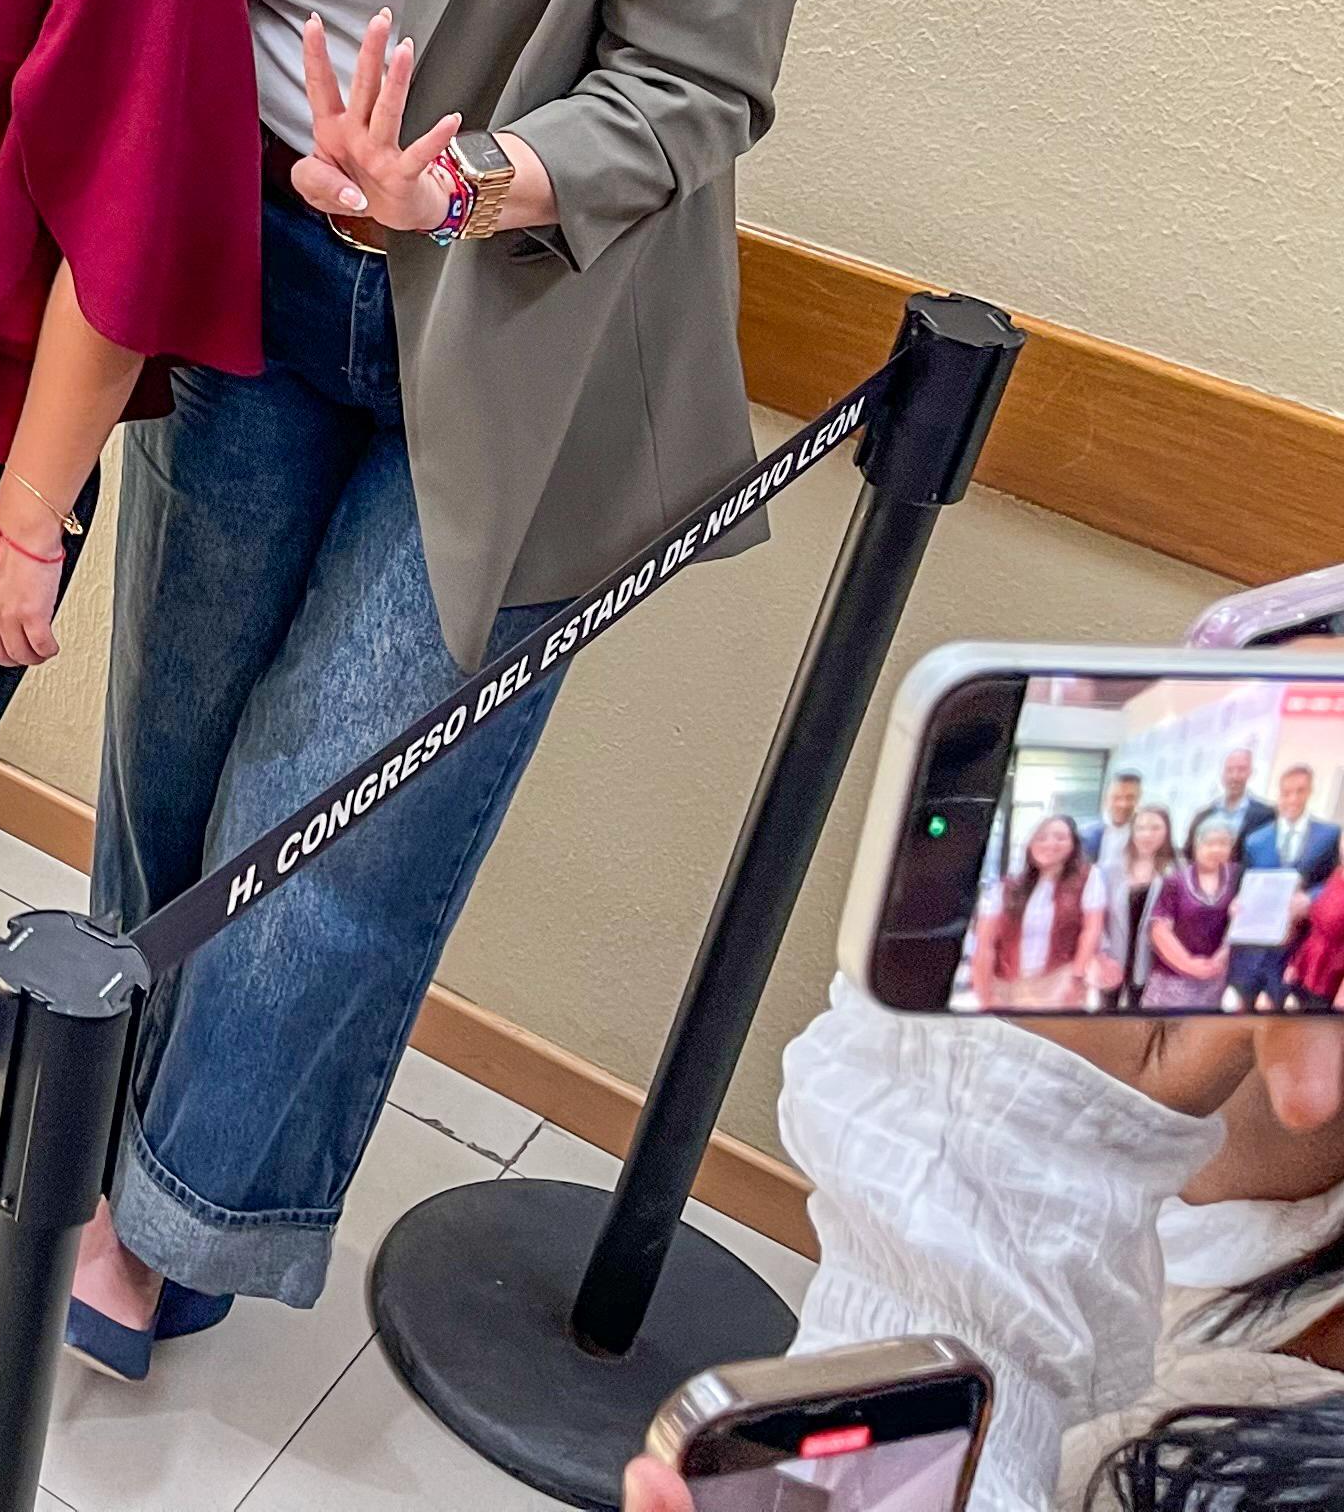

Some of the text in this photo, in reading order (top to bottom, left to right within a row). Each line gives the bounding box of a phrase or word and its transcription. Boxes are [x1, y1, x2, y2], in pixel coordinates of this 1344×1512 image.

[226, 395, 866, 916] H. CONGRESO DEL ESTADO DE NUEVO LEÓN
